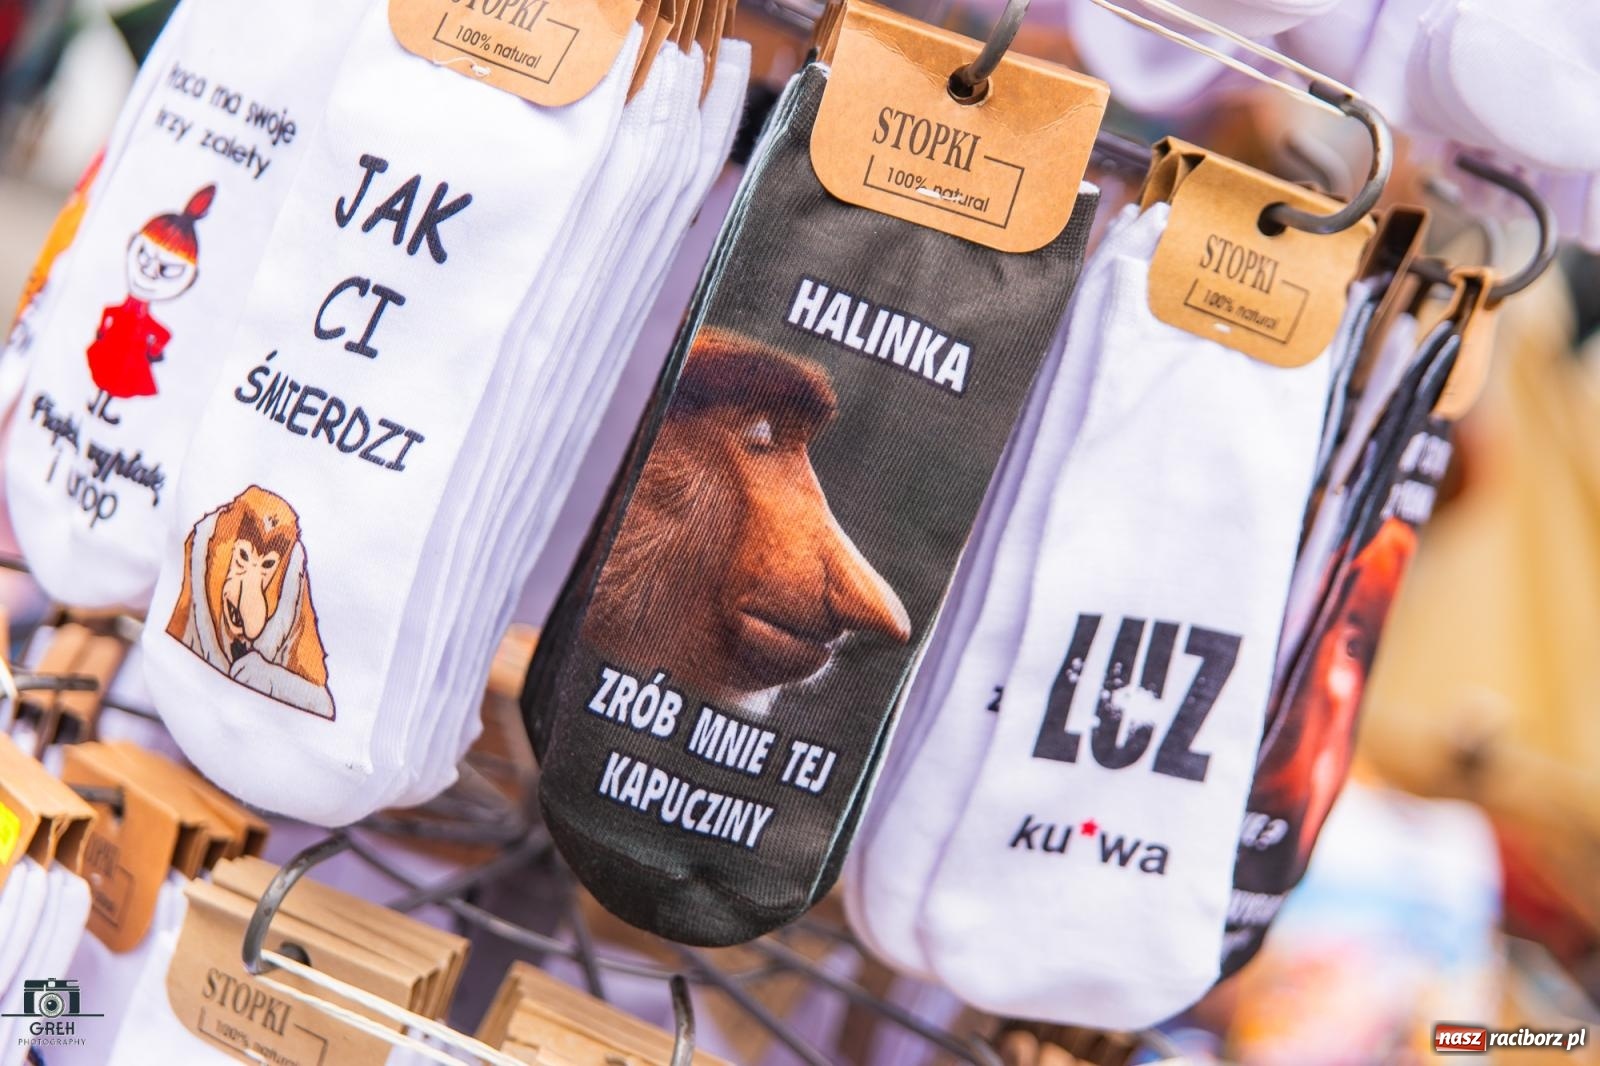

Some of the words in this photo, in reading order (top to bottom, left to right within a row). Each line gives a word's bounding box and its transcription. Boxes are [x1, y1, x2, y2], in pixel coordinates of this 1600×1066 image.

[451, 0, 549, 32] OPKI
[455, 24, 493, 52] 100%
[493, 42, 543, 69] natural
[200, 129, 271, 179] zalety
[246, 101, 296, 146] swoje
[871, 106, 981, 173] STOPKI
[335, 153, 473, 264] JAK
[887, 166, 928, 190] 100%
[933, 185, 990, 213] natural
[1199, 233, 1280, 295] STOPKI
[313, 275, 407, 359] CI
[786, 277, 972, 394] HALINKA
[233, 349, 426, 472] ŚMIERDZI
[67, 468, 118, 528] urop
[587, 667, 684, 738] ZRÓB
[687, 706, 777, 775] MNIE
[780, 740, 838, 793] TEJ
[1031, 612, 1244, 783] LUZ
[598, 751, 775, 848] KAPUCZINY
[202, 966, 292, 1037] STOPKI
